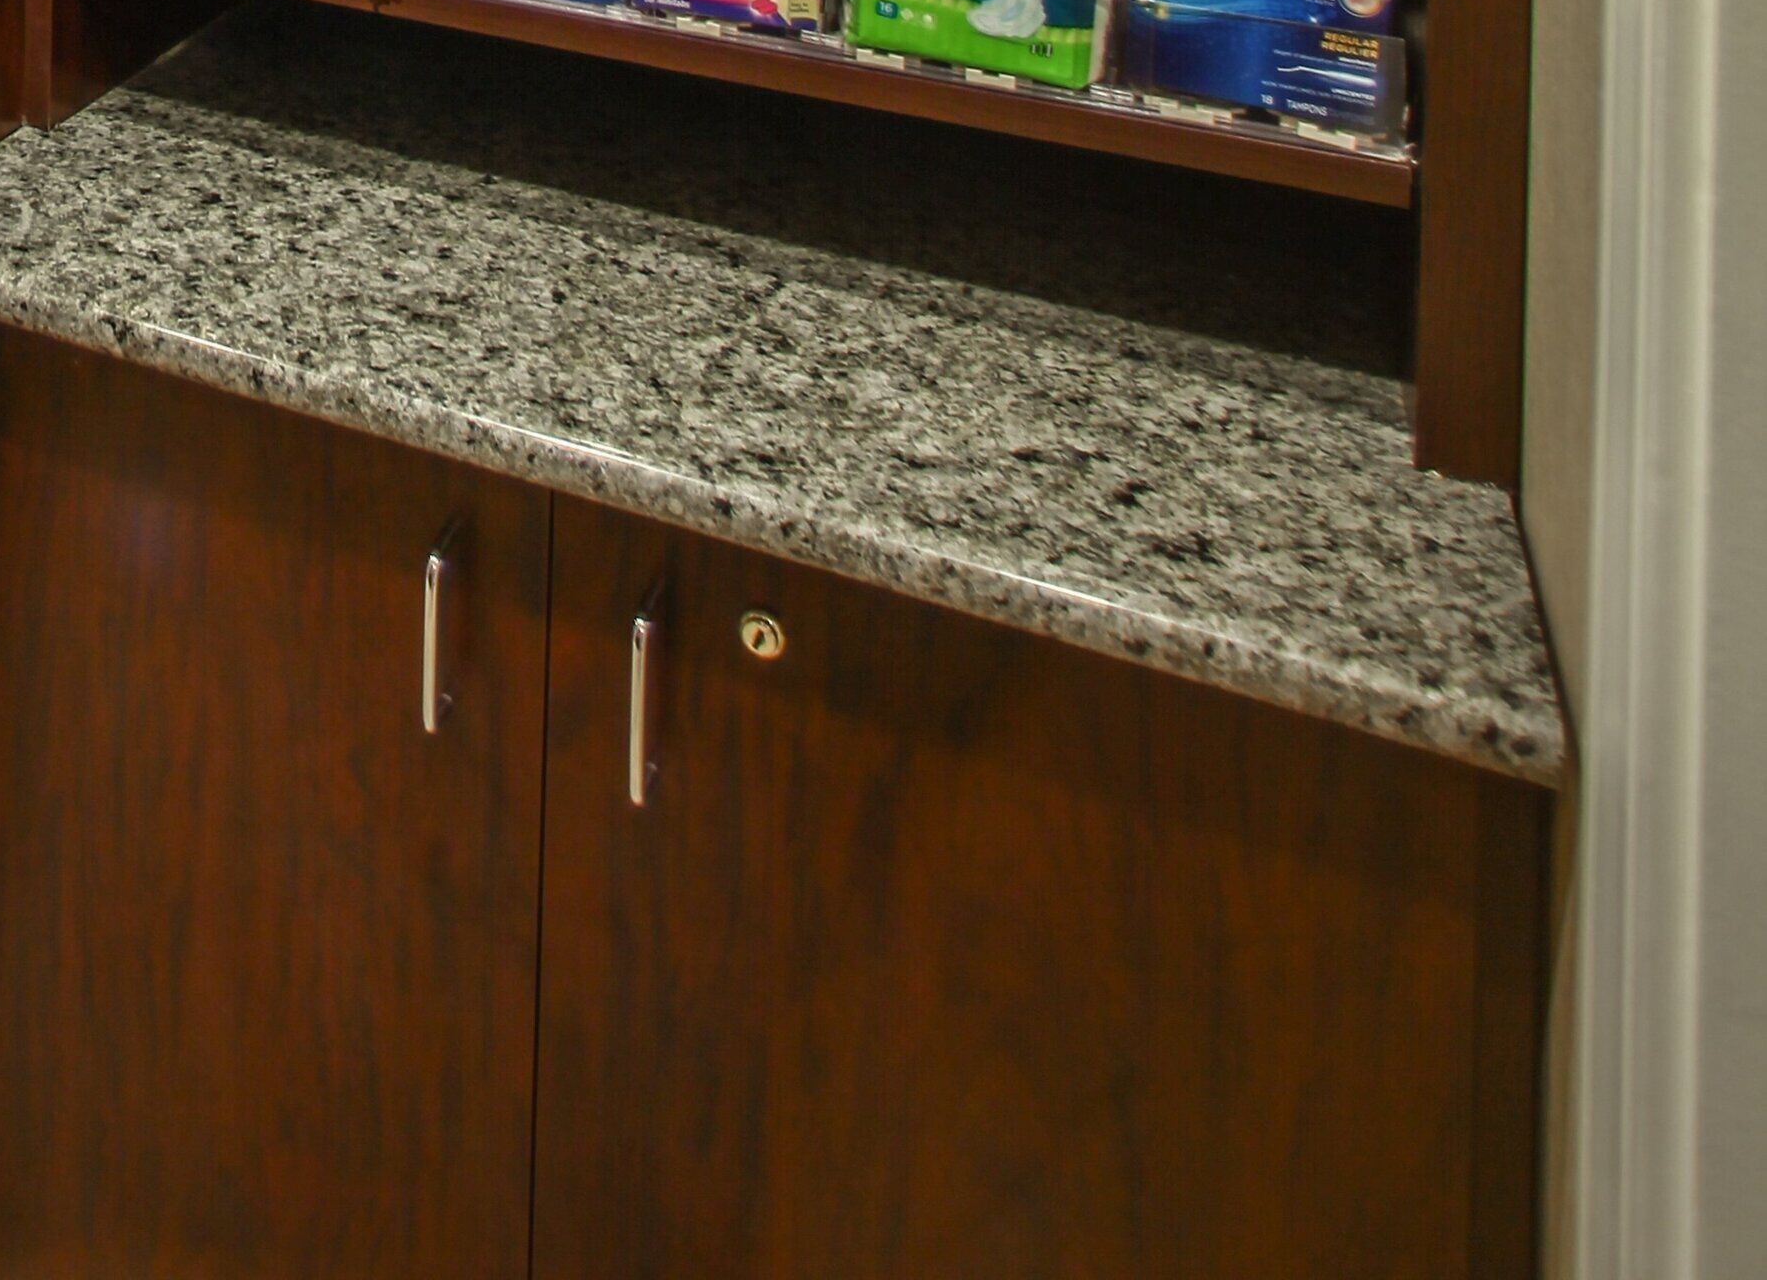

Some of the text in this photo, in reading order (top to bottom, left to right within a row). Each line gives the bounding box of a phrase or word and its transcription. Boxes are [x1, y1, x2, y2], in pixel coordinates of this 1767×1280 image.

[879, 1, 893, 13] 16
[1323, 32, 1379, 48] REGULAR
[1260, 93, 1274, 106] 18
[1286, 99, 1328, 117] TAMPONS
